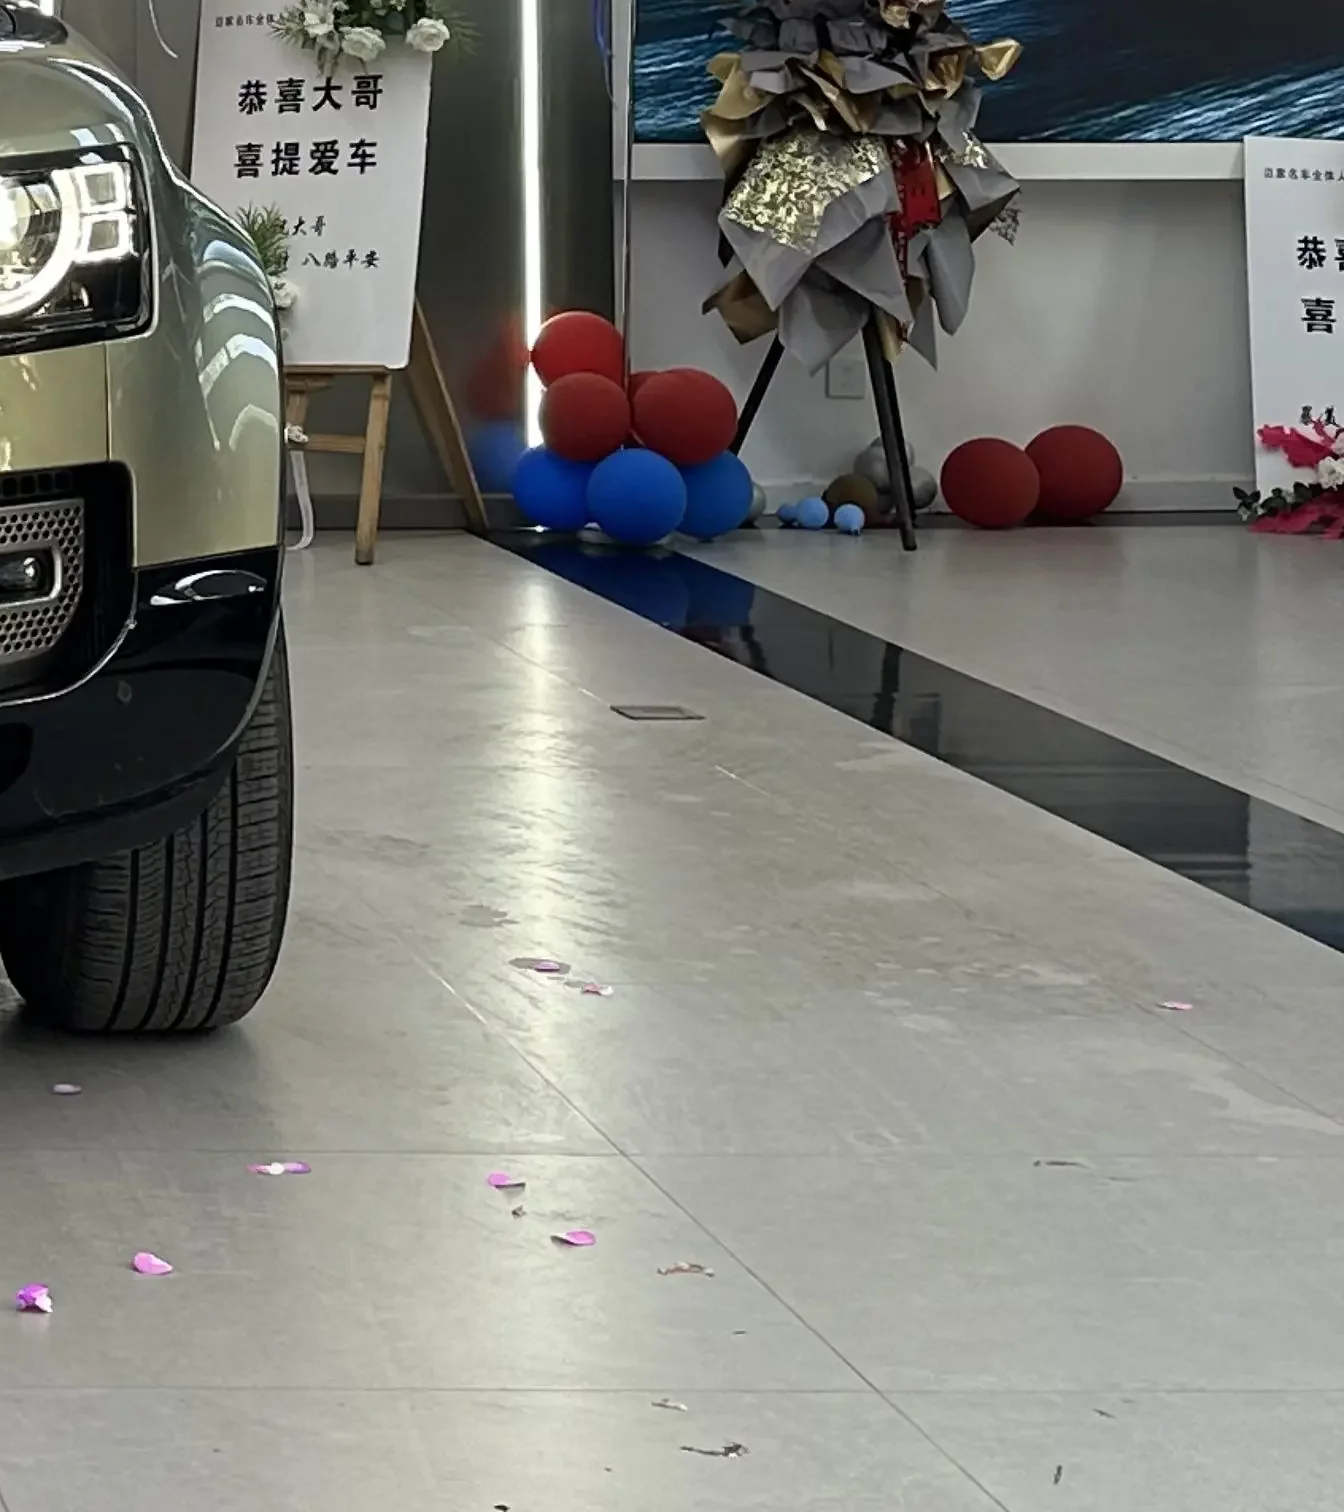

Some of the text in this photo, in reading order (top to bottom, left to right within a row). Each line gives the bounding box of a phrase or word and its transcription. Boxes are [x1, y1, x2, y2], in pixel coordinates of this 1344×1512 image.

[237, 74, 384, 115] 恭喜大哥
[233, 139, 378, 179] 喜提爱车
[1299, 297, 1338, 335] 喜
